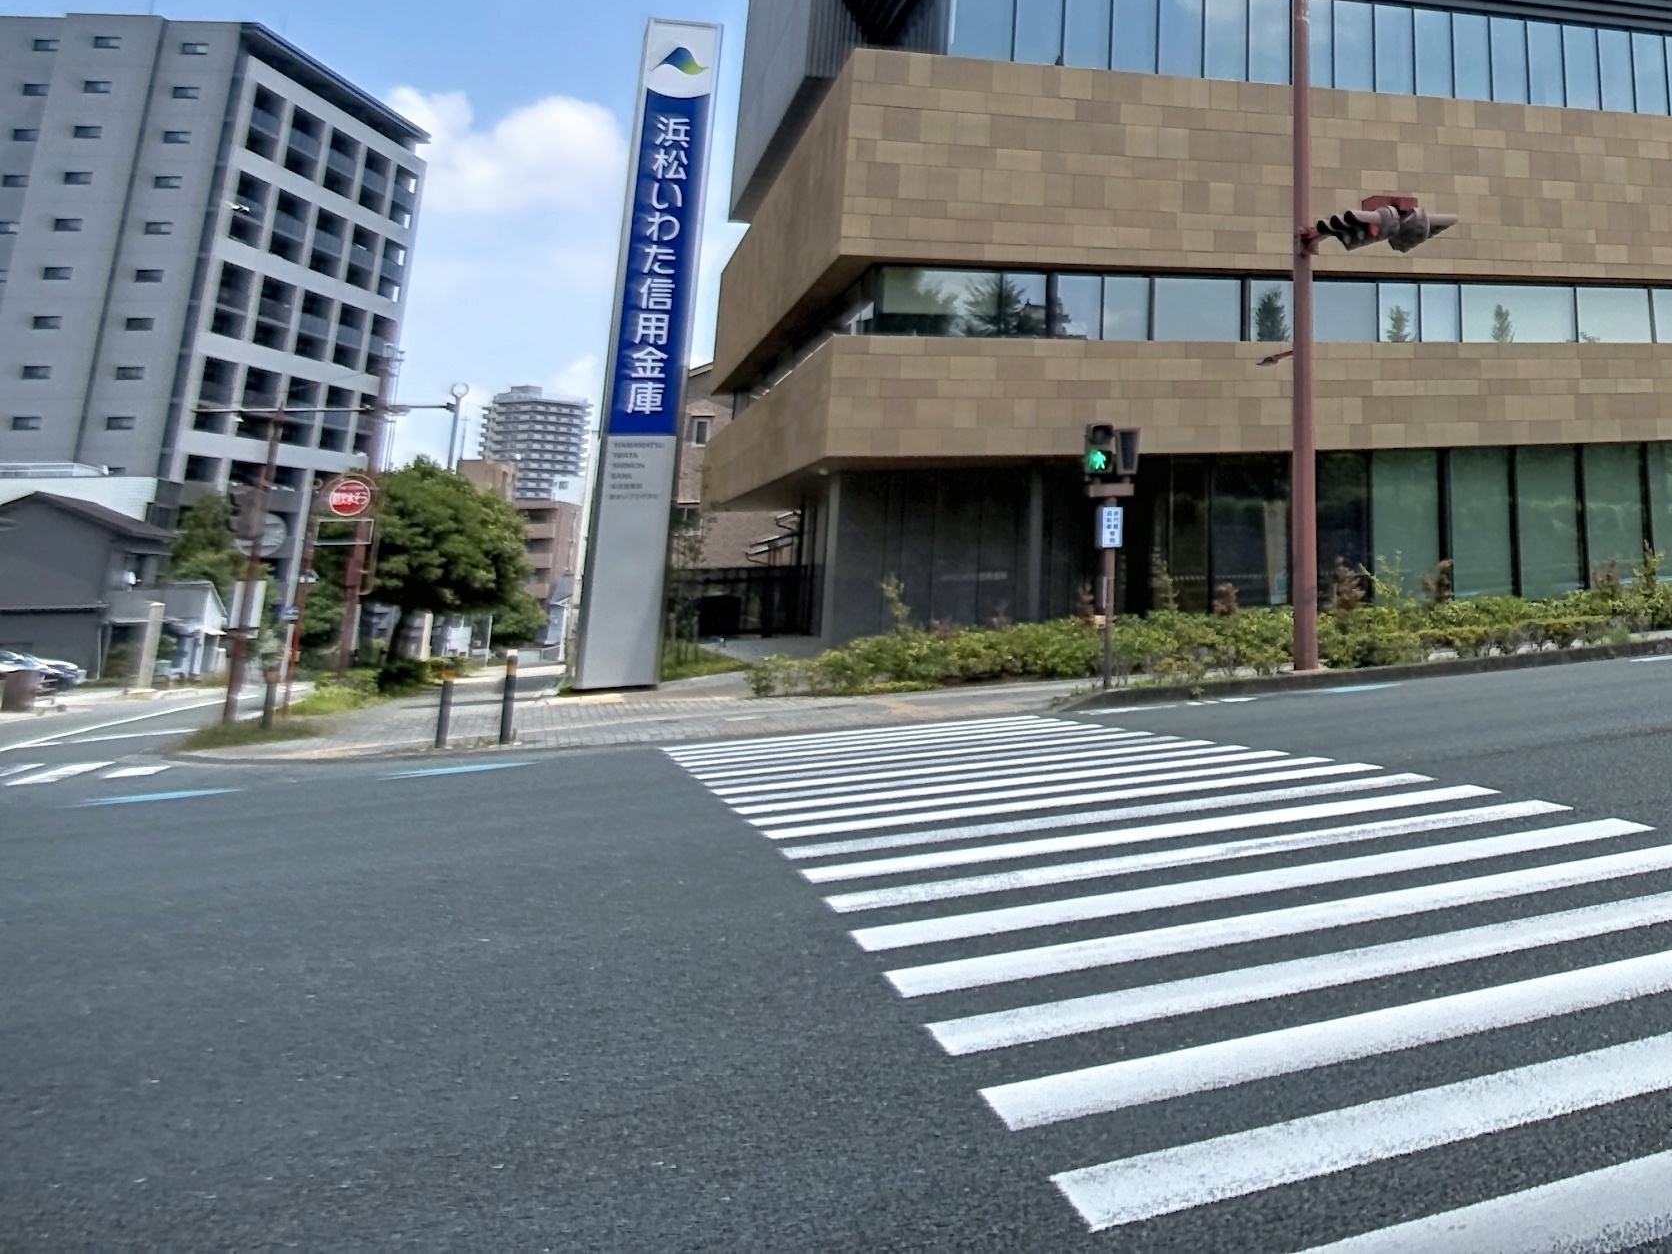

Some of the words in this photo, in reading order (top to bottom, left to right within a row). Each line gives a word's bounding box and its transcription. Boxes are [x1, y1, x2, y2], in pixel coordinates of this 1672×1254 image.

[625, 115, 691, 415] 浜松いわた信用金庫
